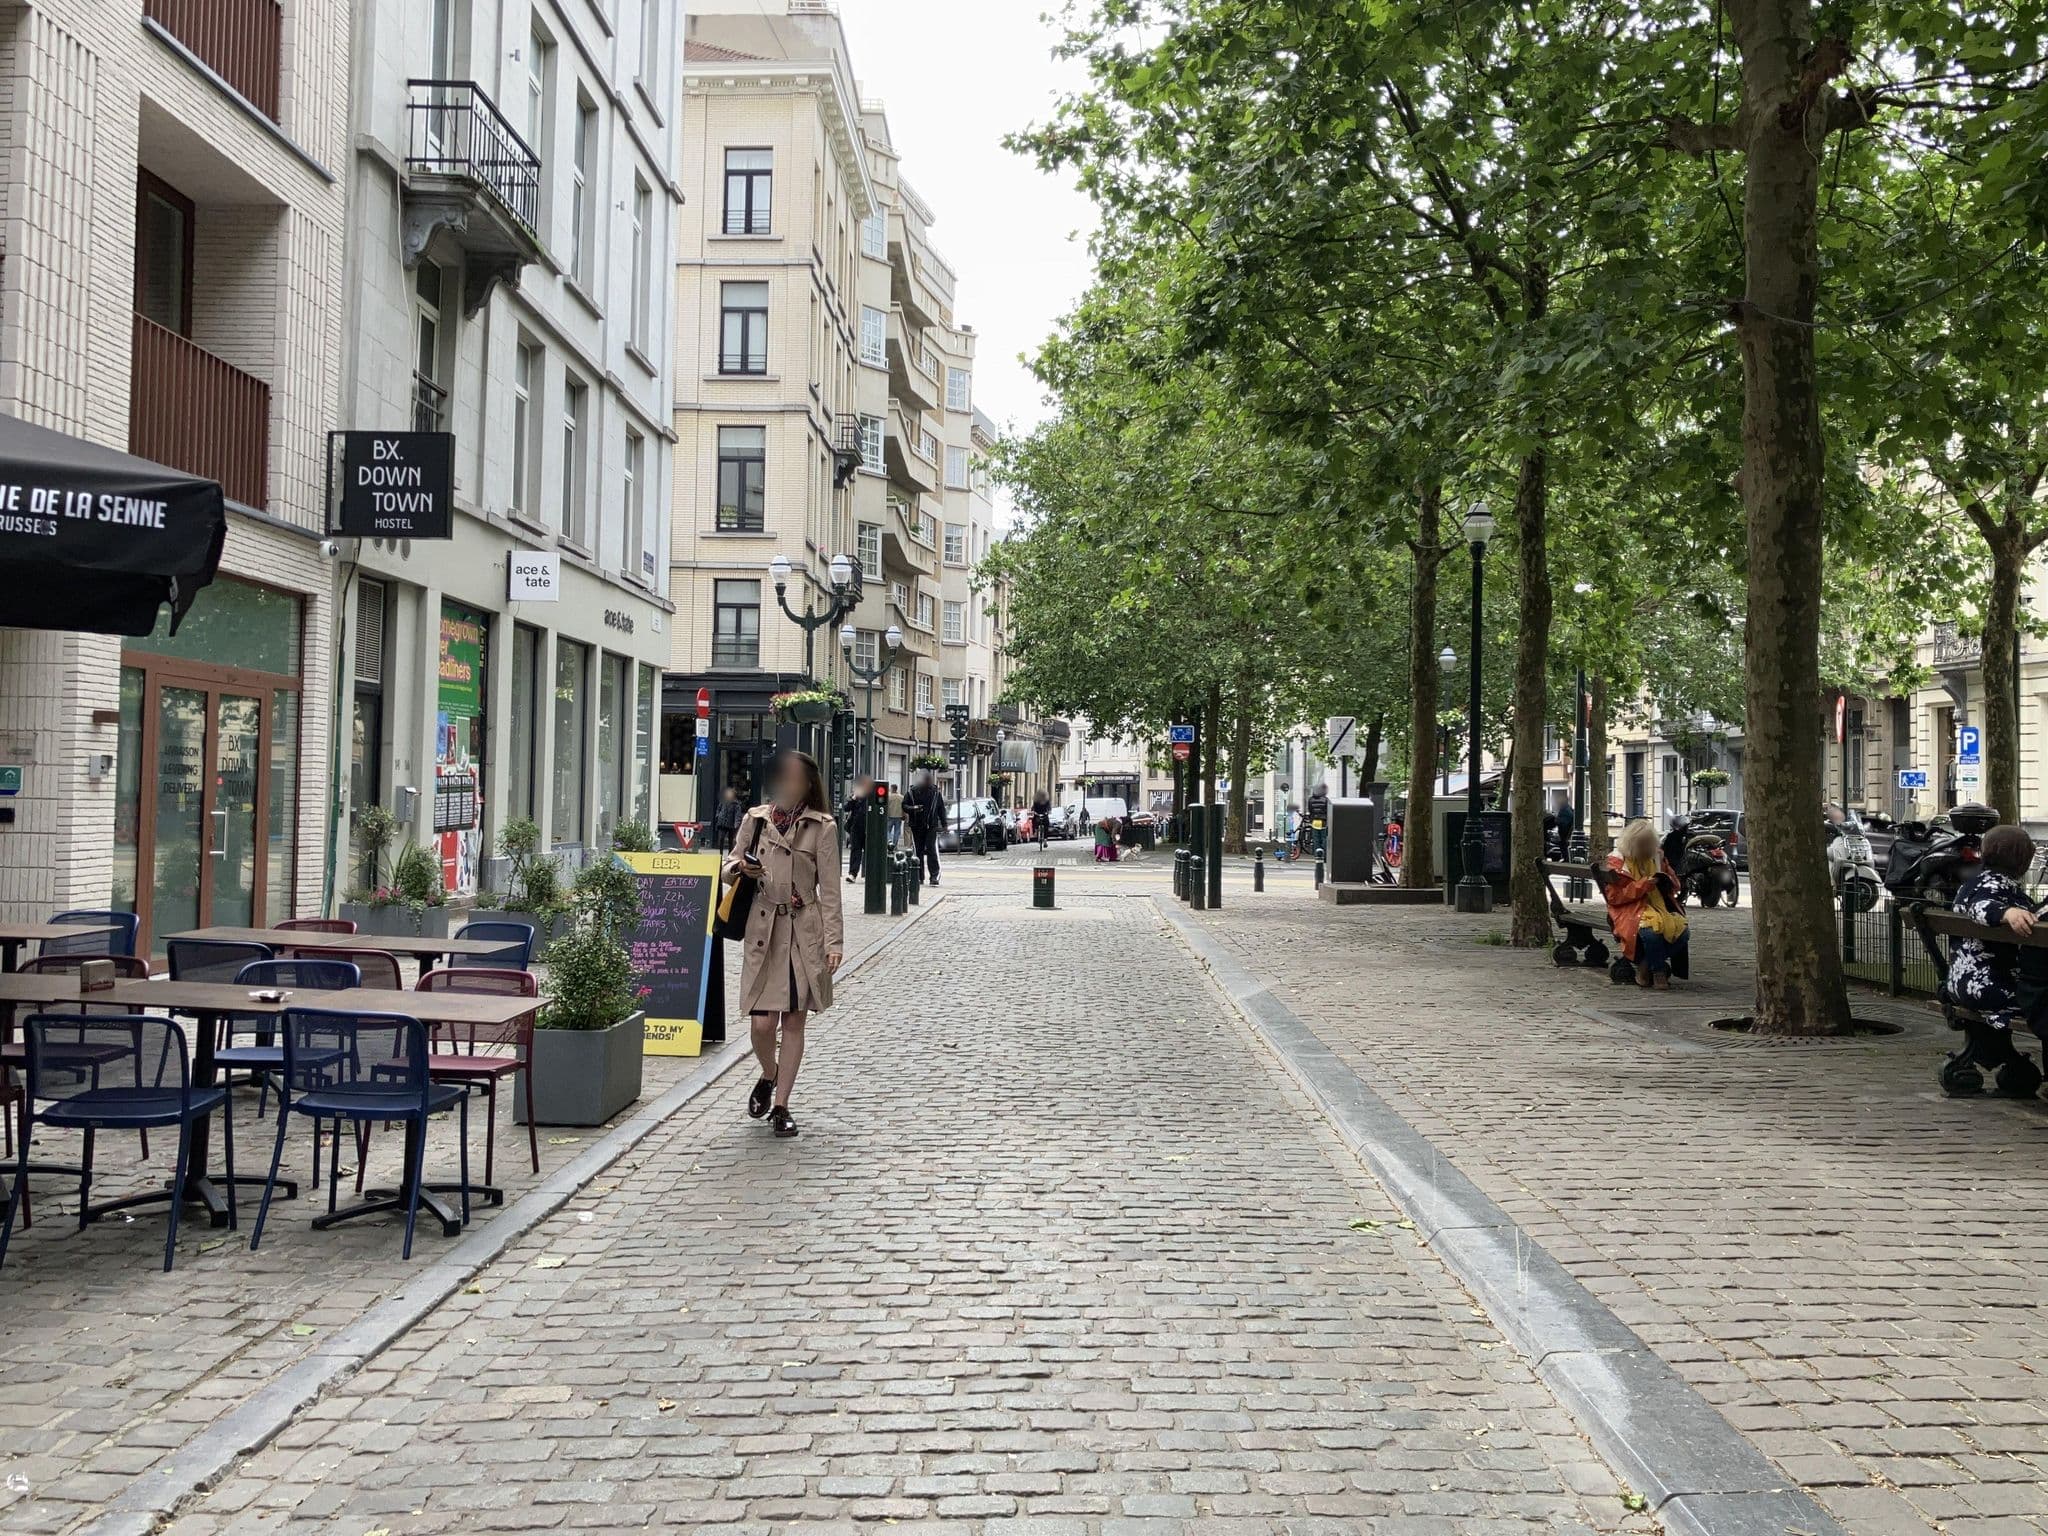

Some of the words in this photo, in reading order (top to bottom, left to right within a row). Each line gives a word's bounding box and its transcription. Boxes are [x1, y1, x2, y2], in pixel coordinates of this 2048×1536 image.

[373, 440, 404, 460] BX.
[358, 466, 421, 486] DOWN
[30, 488, 61, 515] DE
[64, 491, 93, 519] LA
[97, 494, 168, 528] SENNE
[372, 492, 433, 512] TOWN
[375, 518, 414, 529] HOSTEL
[515, 566, 538, 575] ace
[541, 565, 550, 575] &
[525, 577, 551, 587] tate
[1963, 732, 1977, 750] P
[879, 806, 885, 815] 3
[664, 891, 684, 902] 22h
